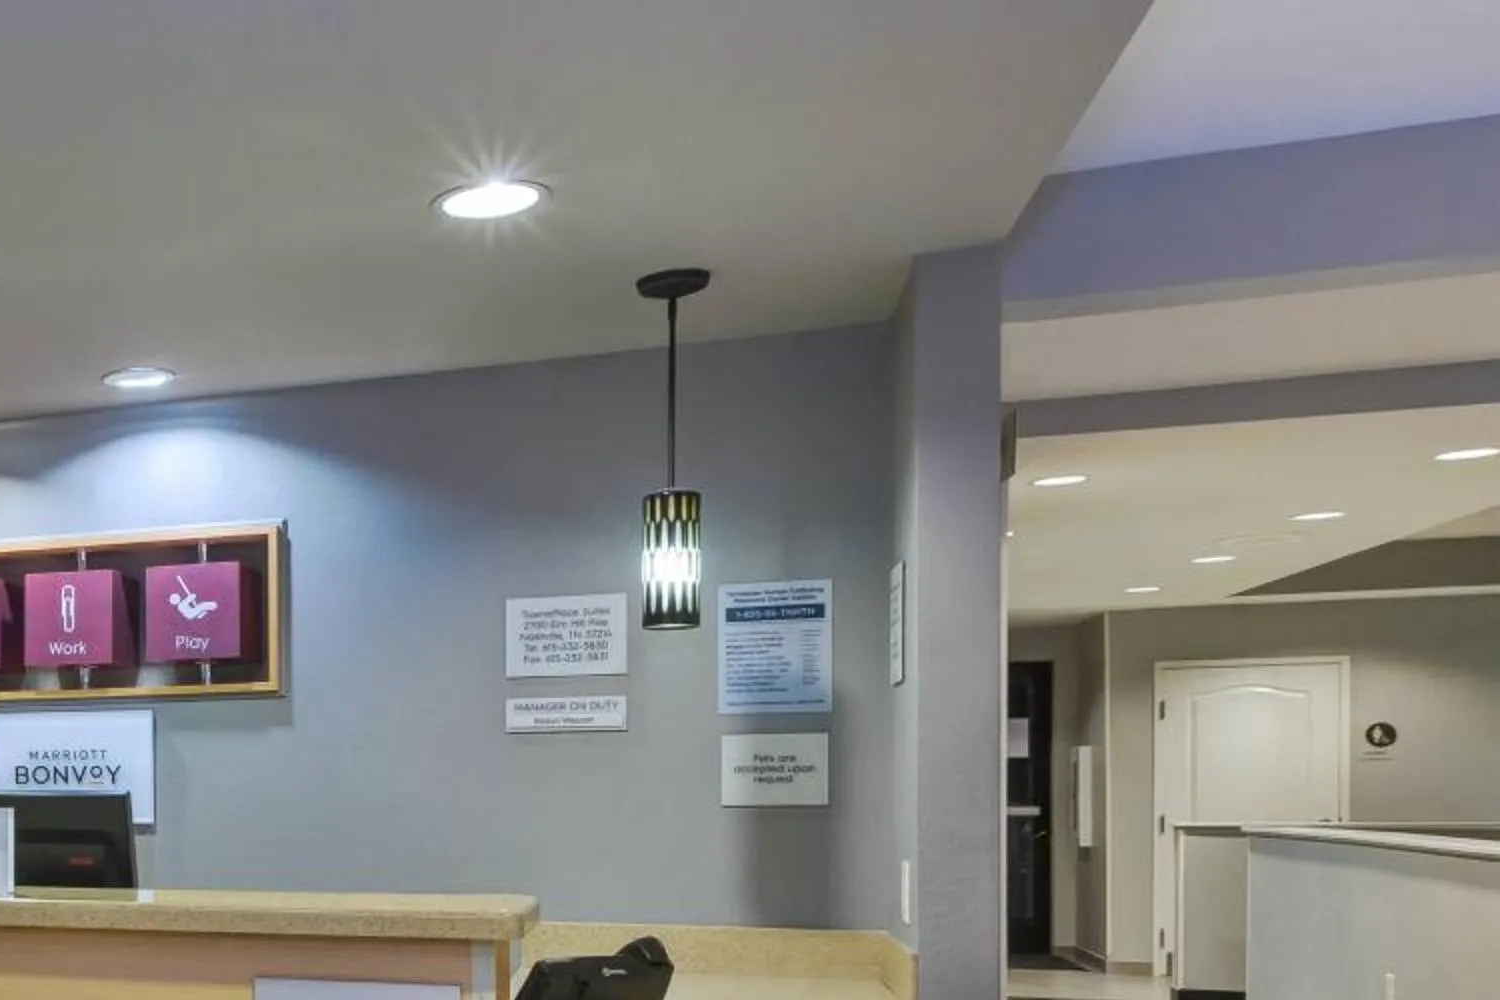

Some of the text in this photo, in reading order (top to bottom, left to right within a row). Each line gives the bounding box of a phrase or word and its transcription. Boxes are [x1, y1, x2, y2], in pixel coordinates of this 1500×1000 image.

[48, 641, 88, 656] Work
[175, 635, 211, 652] Play
[513, 700, 619, 711] MANAGER ON DUTY
[29, 749, 108, 762] MARRIOTT
[778, 754, 797, 763] are
[14, 764, 121, 785] BONVOY
[734, 764, 817, 775] accepted upon
[753, 774, 794, 785] request
